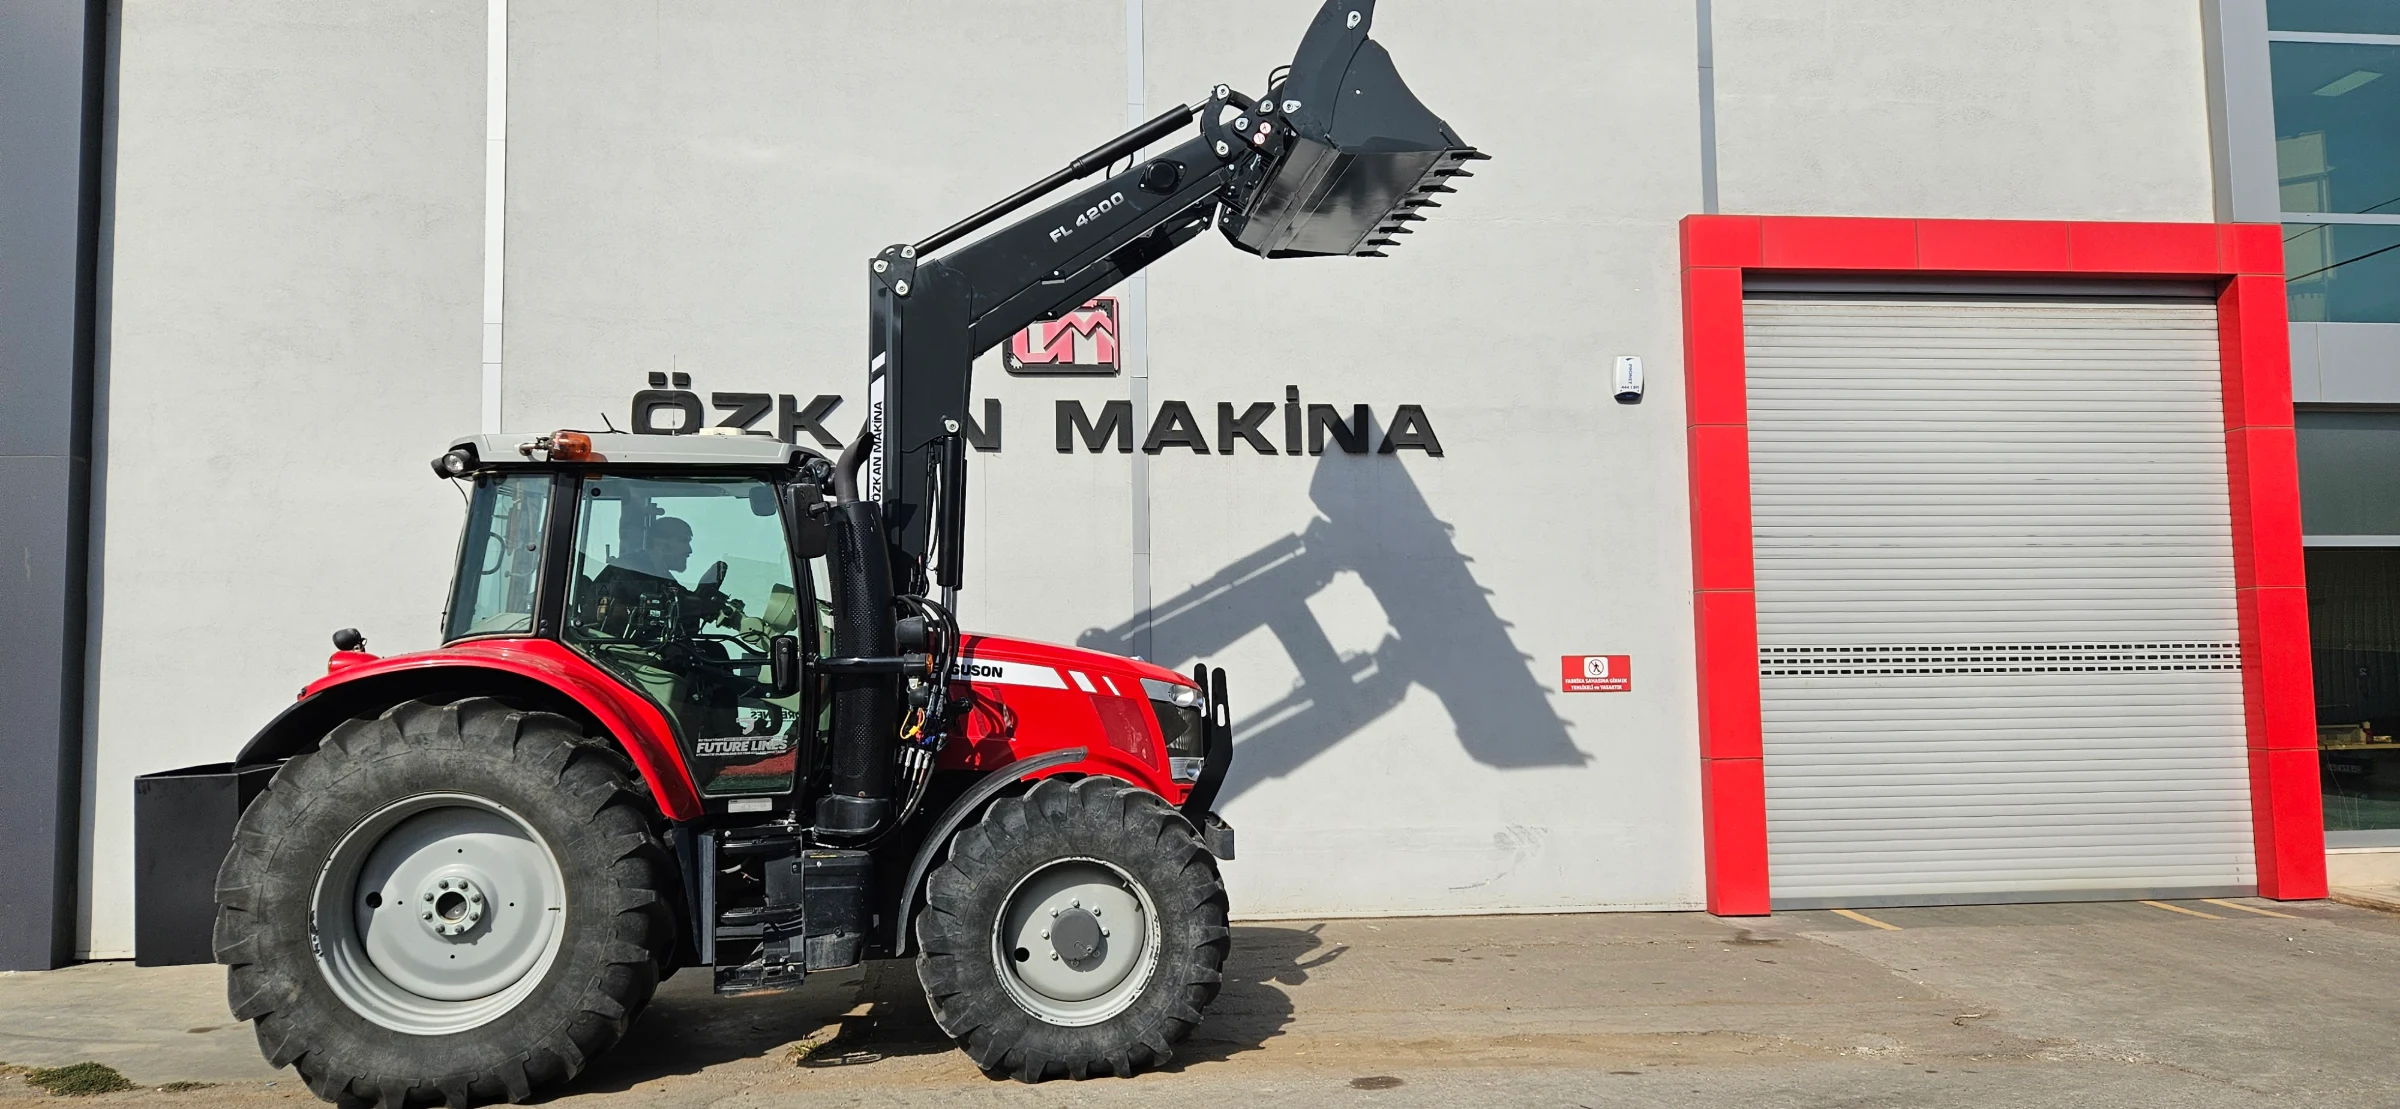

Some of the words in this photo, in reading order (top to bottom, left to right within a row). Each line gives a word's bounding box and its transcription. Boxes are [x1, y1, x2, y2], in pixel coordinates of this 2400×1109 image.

[1049, 225, 1073, 243] FL
[1075, 191, 1125, 228] 4200
[631, 371, 1001, 452] ÖZKN
[1055, 384, 1444, 456] MAKİNA
[871, 401, 883, 453] MAKİNA
[871, 457, 883, 502] ÖZKAN
[951, 664, 1002, 678] GUSON
[696, 740, 750, 753] FUTURE
[750, 739, 788, 752] LINES
